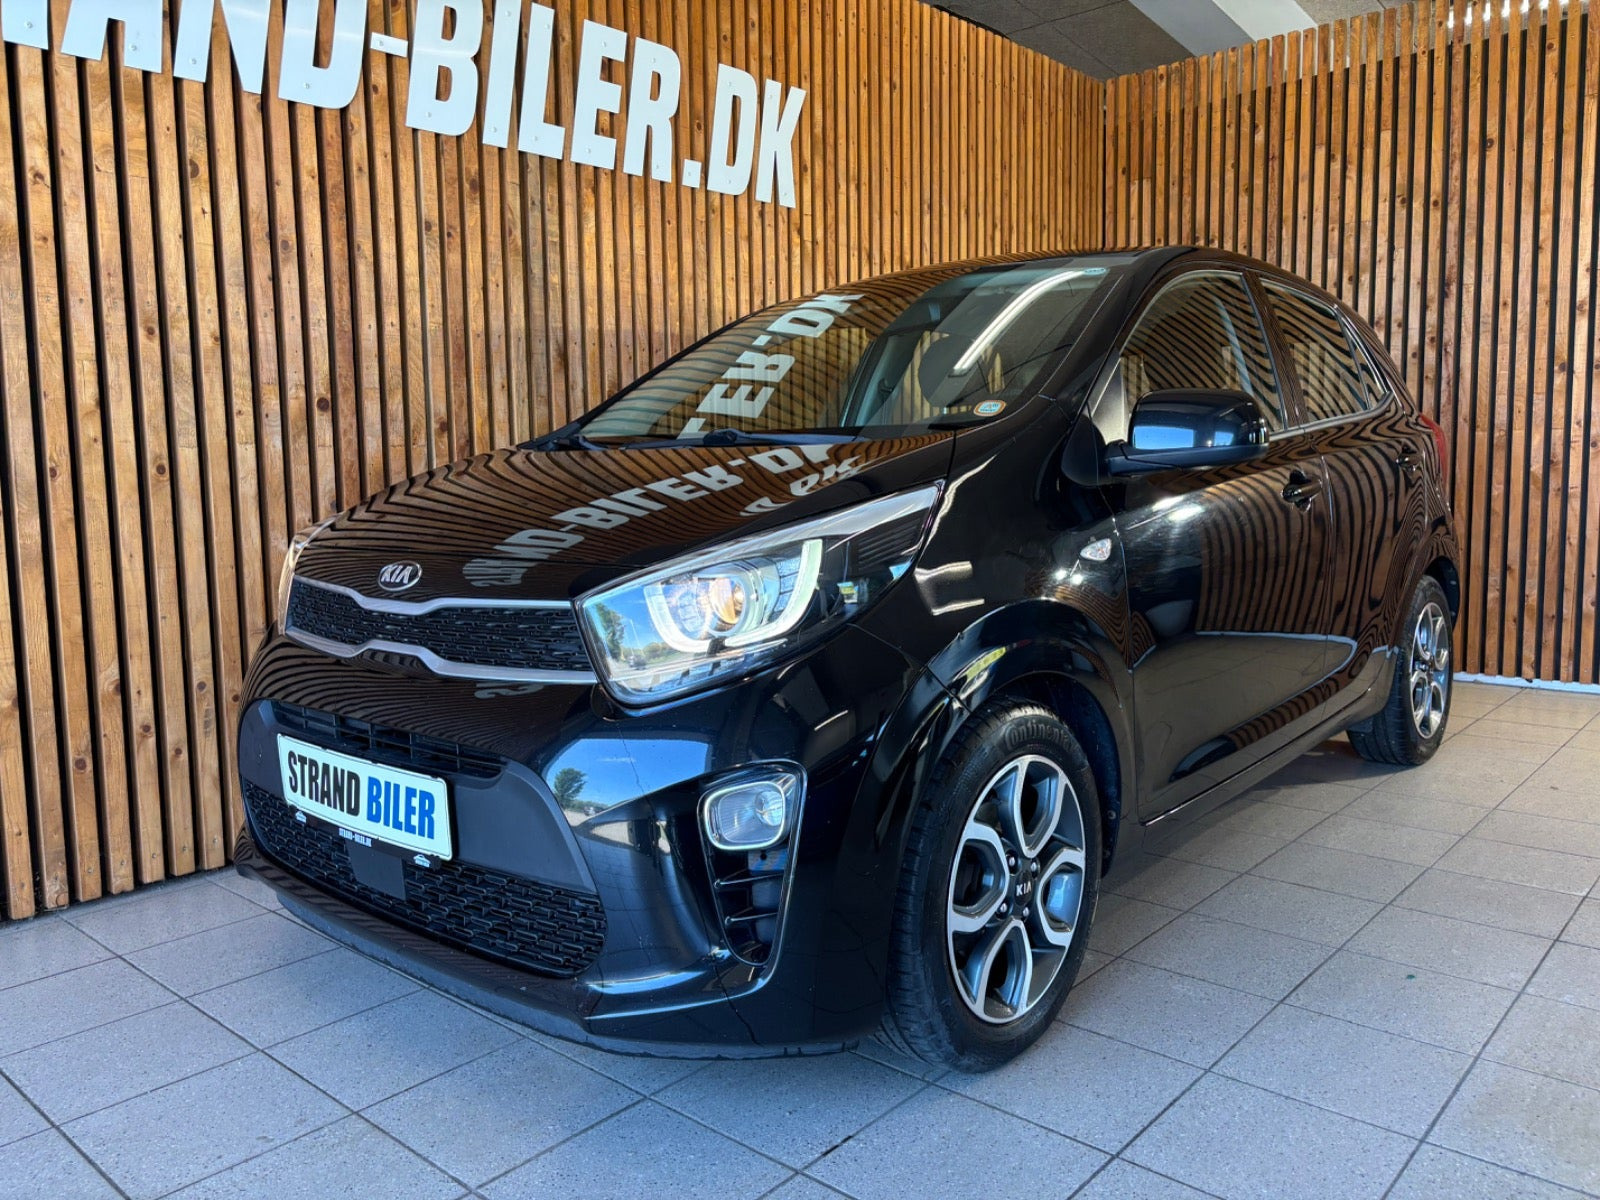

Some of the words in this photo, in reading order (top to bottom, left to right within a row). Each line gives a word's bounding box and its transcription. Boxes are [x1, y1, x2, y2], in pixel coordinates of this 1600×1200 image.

[0, 0, 806, 209] D-BILER.DK
[380, 564, 413, 585] KIA
[288, 751, 360, 816] STRAND
[367, 776, 435, 839] BILER
[1016, 881, 1031, 896] KIA
